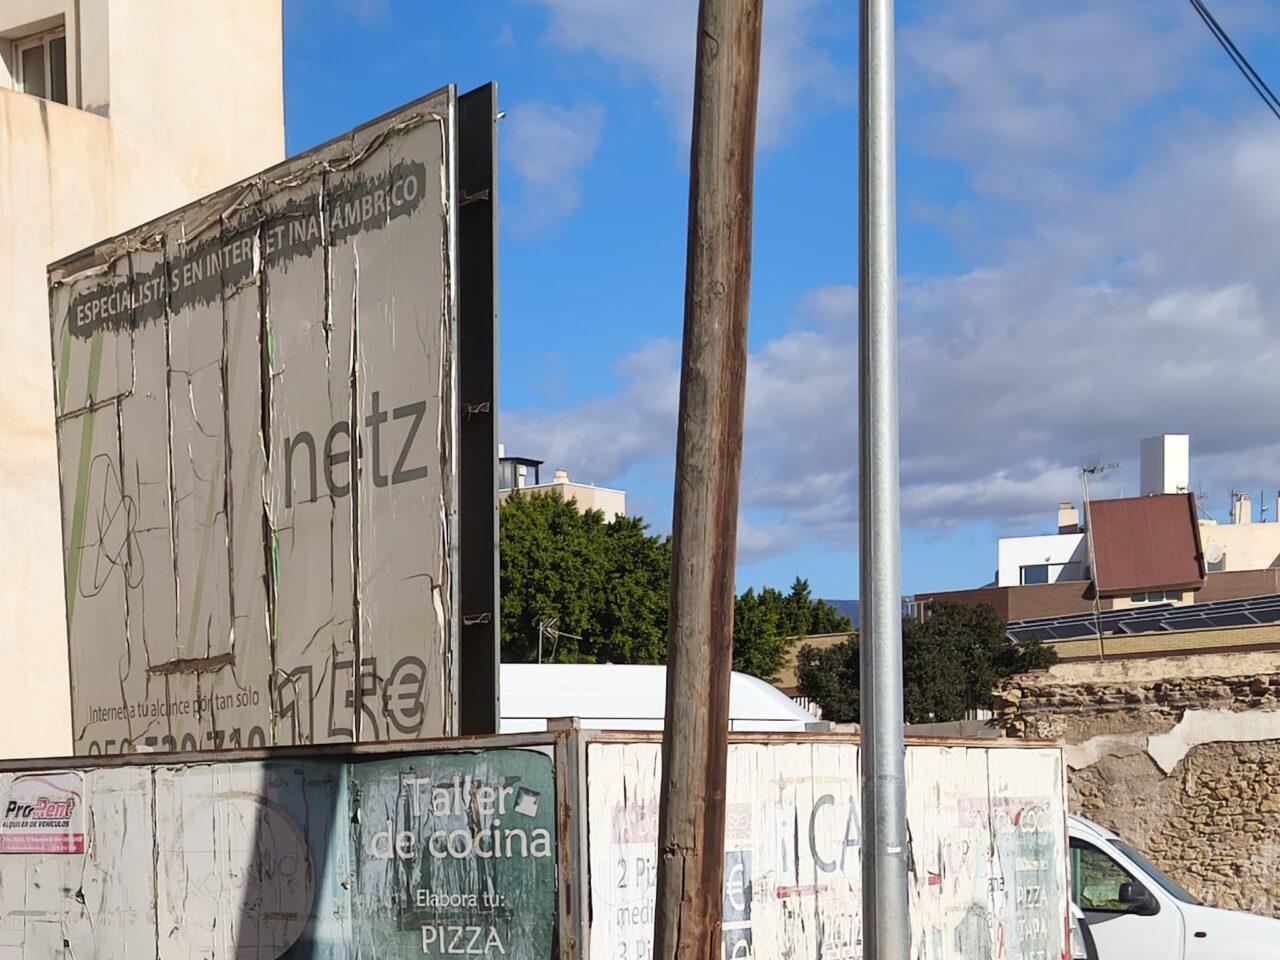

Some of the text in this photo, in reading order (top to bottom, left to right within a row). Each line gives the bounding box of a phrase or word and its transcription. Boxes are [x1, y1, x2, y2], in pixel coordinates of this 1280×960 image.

[77, 268, 181, 327] ESPECIALISTAS
[183, 258, 202, 288] EN
[206, 227, 286, 278] INTERET
[283, 390, 429, 510] netz
[89, 705, 128, 722] Internet
[130, 704, 136, 719] a
[137, 701, 149, 718] tu
[214, 693, 234, 711] tan
[402, 775, 514, 817] Taller
[371, 818, 552, 860] de cocina
[616, 857, 628, 889] 2
[415, 889, 505, 908] Elabora tu:
[420, 924, 506, 955] PIZZA
